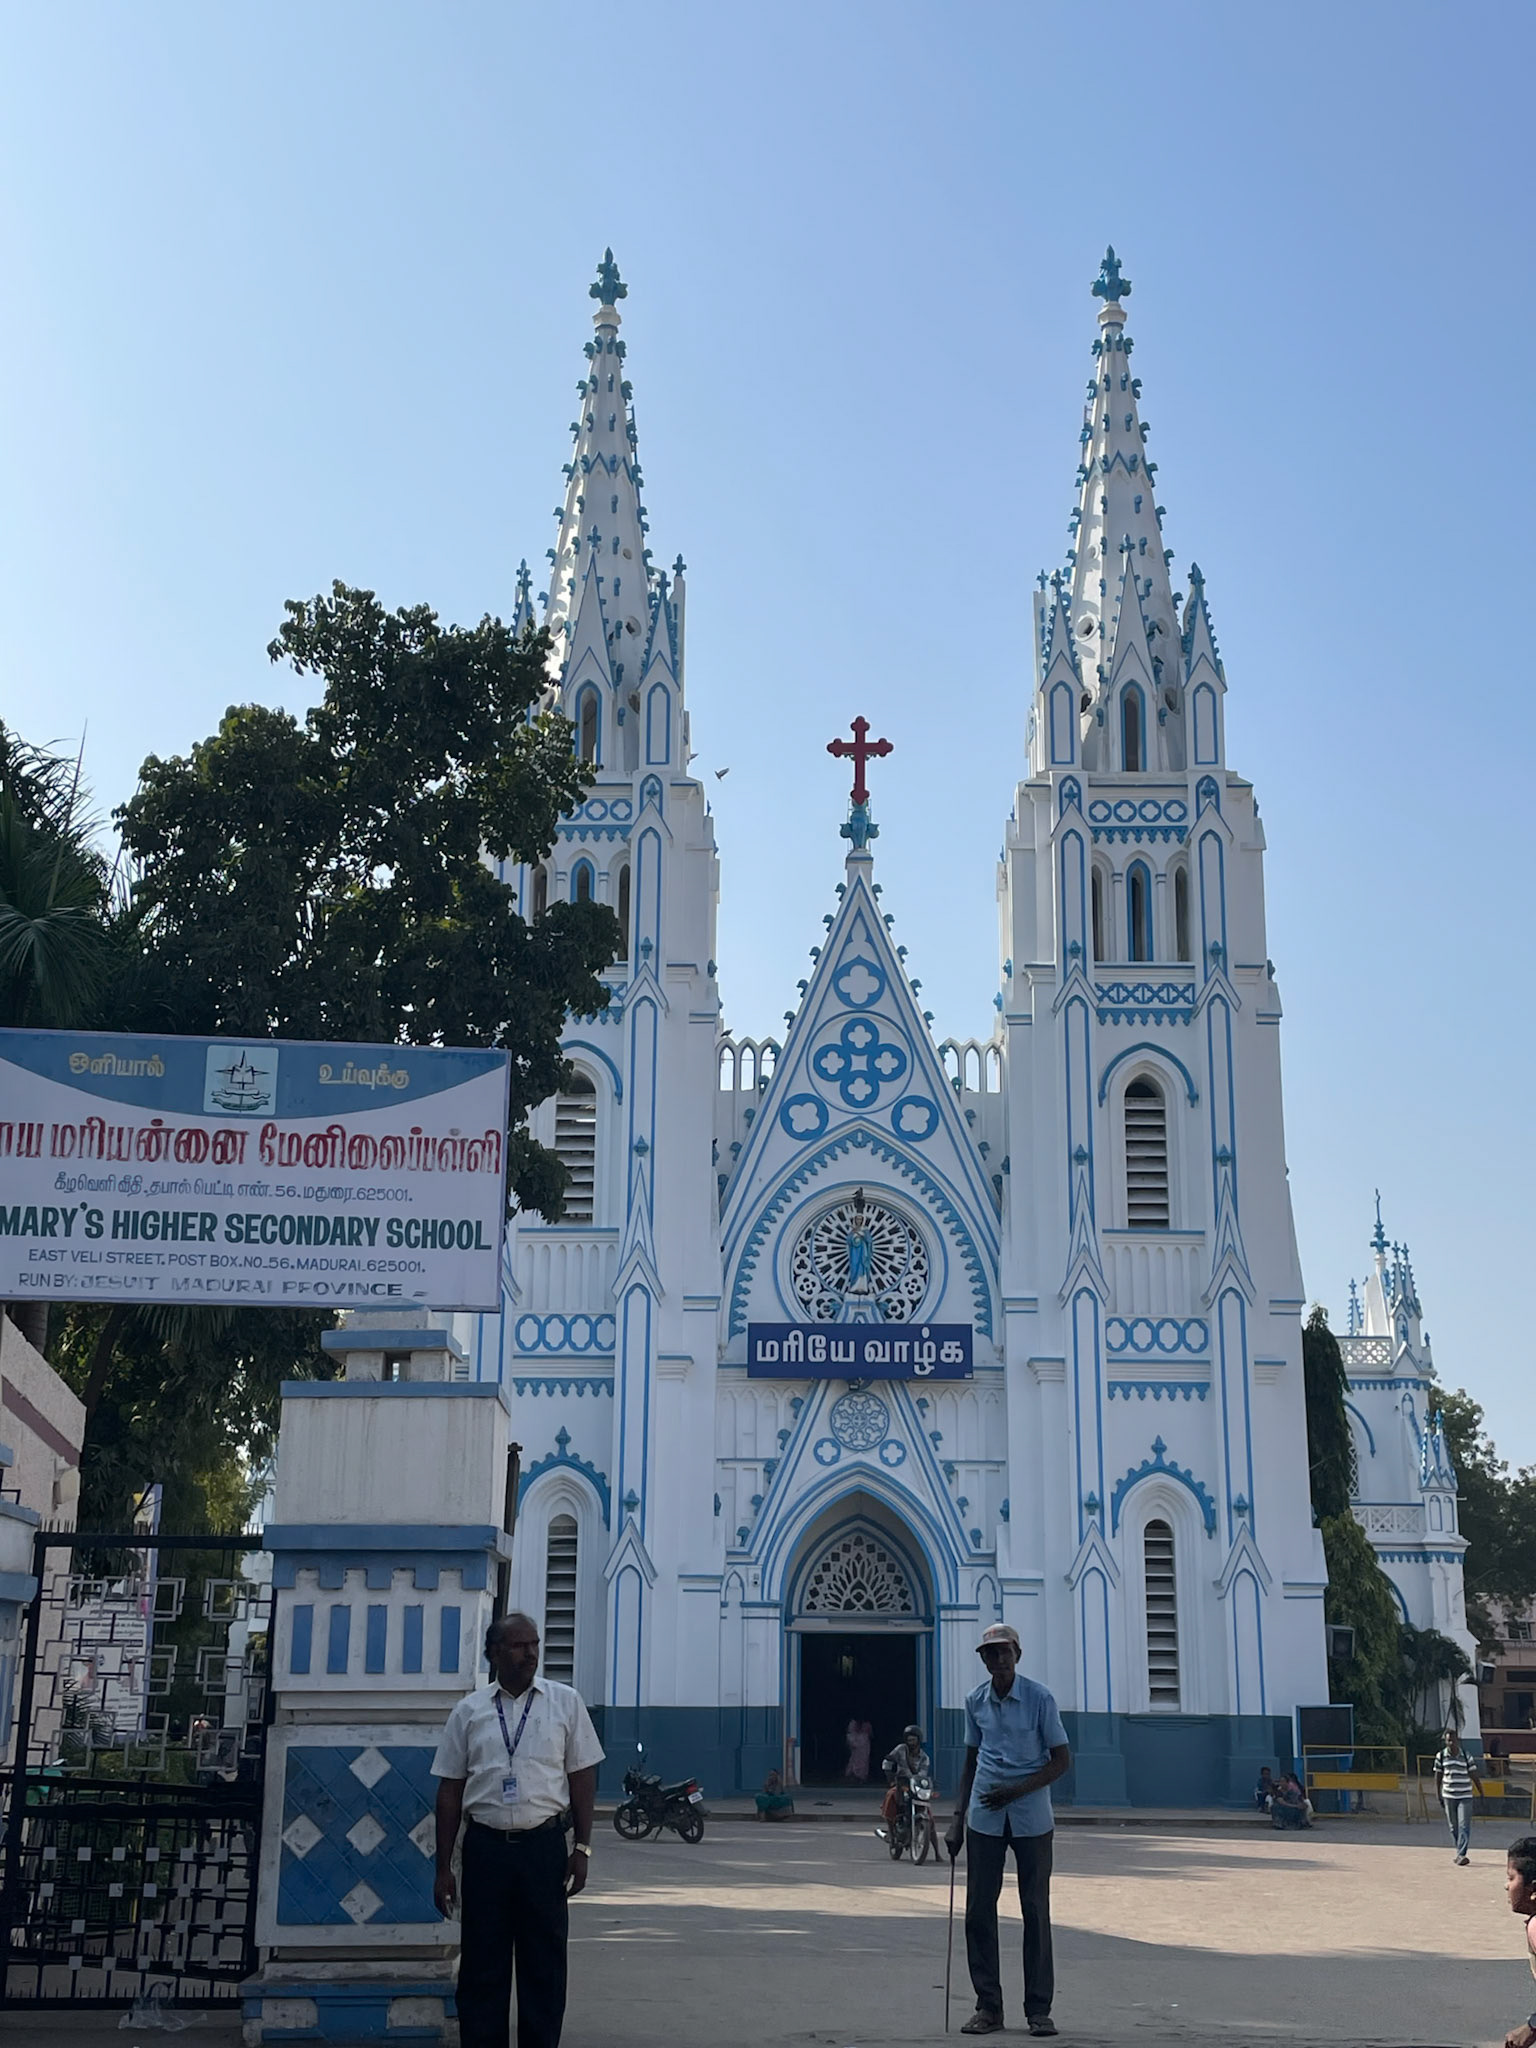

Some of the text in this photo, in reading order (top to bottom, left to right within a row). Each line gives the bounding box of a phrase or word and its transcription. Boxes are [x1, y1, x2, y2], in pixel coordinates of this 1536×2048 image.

[50, 1116, 249, 1165] மரியன்னை
[259, 1122, 501, 1175] மேனிலைப்பள்ளி
[0, 1201, 492, 1250] MARY'S HIGHER SECONDARY SCHOOL
[28, 1249, 67, 1262] EAST
[71, 1250, 103, 1263] VELI
[168, 1253, 207, 1266] POST
[19, 1273, 51, 1288] RUN
[171, 1276, 273, 1294] MADURAI
[282, 1280, 403, 1297] PROVINCE
[756, 1326, 964, 1376] மரியே வாழ்க
